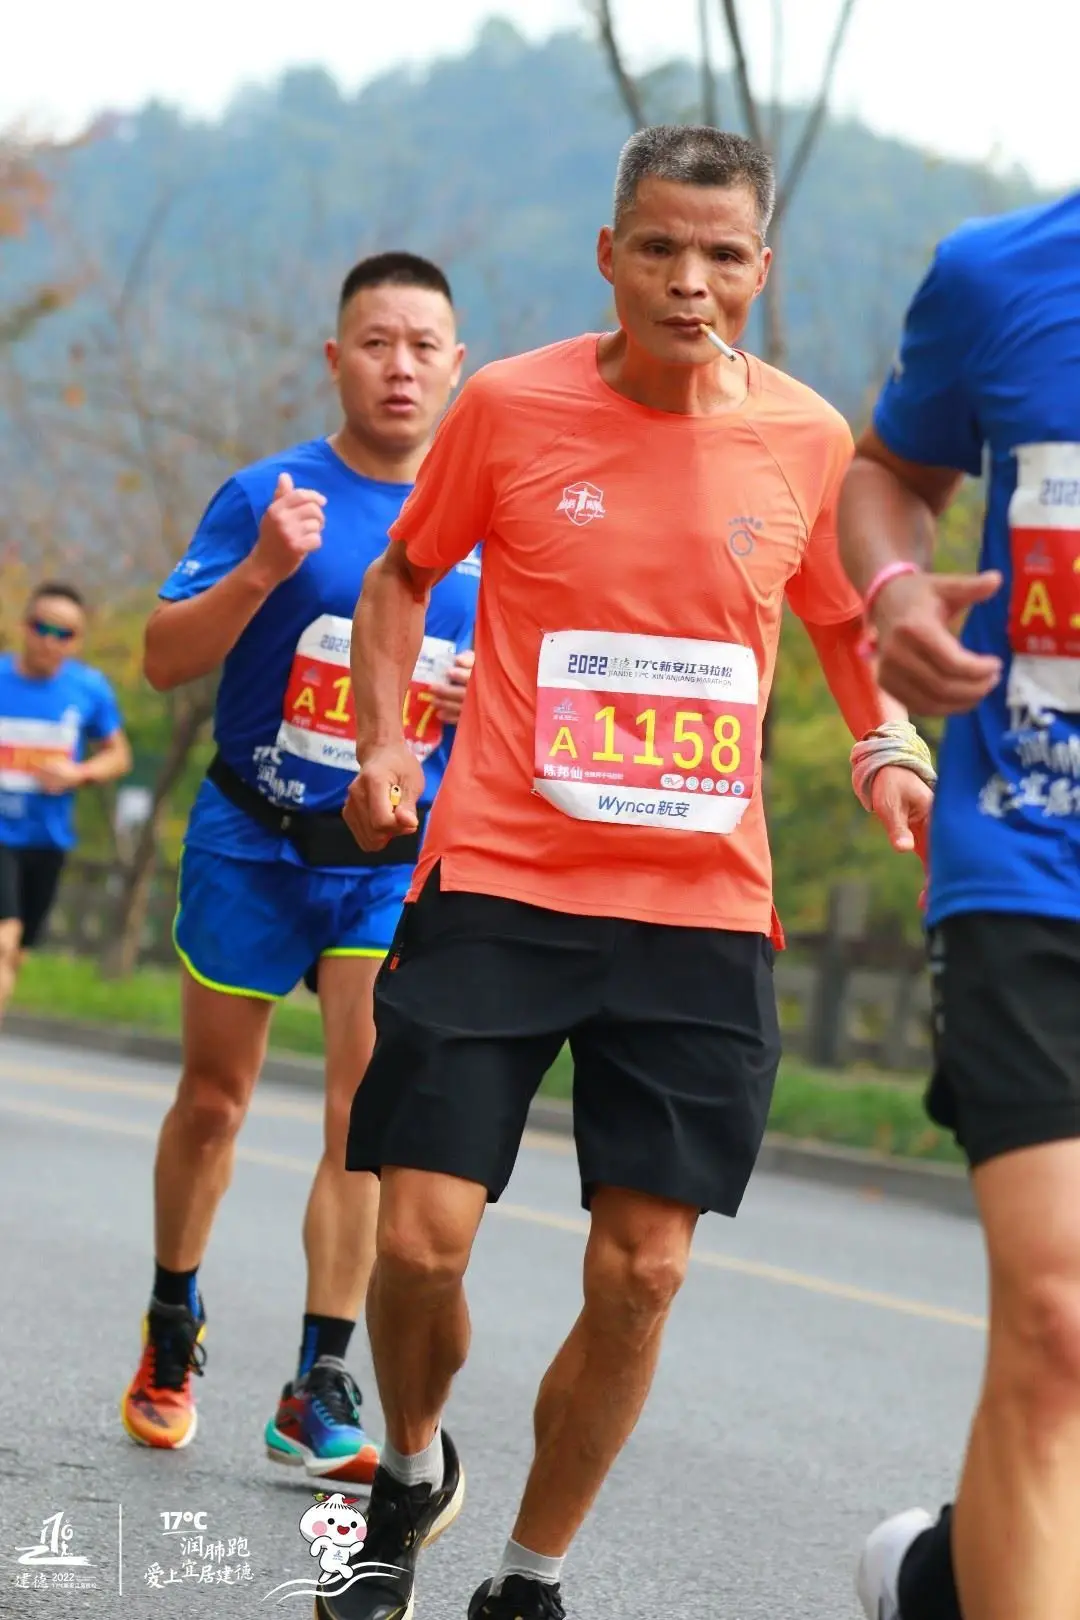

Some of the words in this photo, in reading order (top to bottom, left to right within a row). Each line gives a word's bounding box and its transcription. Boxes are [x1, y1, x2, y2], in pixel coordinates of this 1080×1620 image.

[1020, 580, 1056, 628] A
[567, 654, 609, 676] 2022
[293, 686, 316, 715] A
[549, 727, 578, 759] A
[592, 706, 741, 774] 1158
[597, 795, 655, 815] Wynca
[656, 800, 690, 817] 新安
